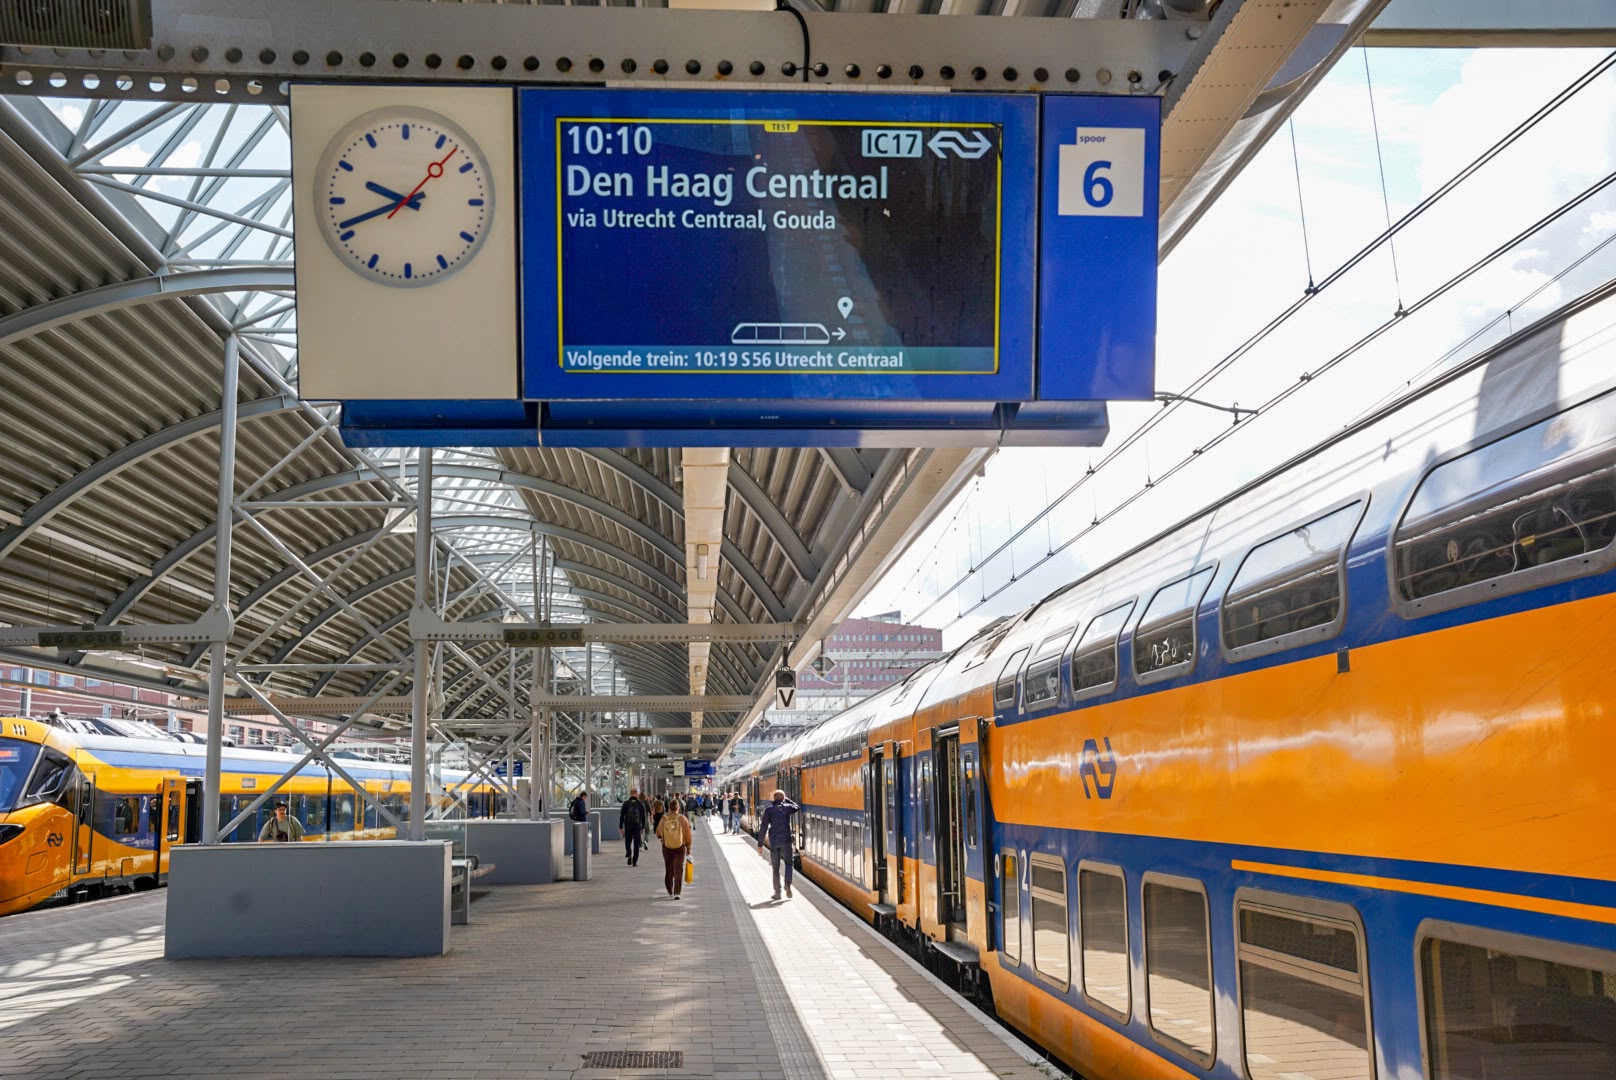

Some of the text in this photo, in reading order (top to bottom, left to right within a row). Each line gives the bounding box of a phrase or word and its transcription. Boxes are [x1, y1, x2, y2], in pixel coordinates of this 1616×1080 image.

[772, 123, 791, 131] TEST
[567, 125, 652, 155] 10:10
[867, 133, 918, 155] IC17
[1080, 136, 1106, 144] spoor
[567, 165, 888, 206] Den Haag Centraal
[1083, 160, 1114, 208] 6
[567, 208, 836, 231] via Utrecht Centraal, Gouda
[567, 350, 641, 370] Volgende
[646, 351, 689, 367] trein:
[694, 352, 738, 367] 10:19
[775, 351, 833, 367] Utrecht
[837, 352, 903, 367] Centraal
[778, 689, 795, 708] V
[142, 796, 148, 813] 2
[1020, 849, 1029, 891] 2
